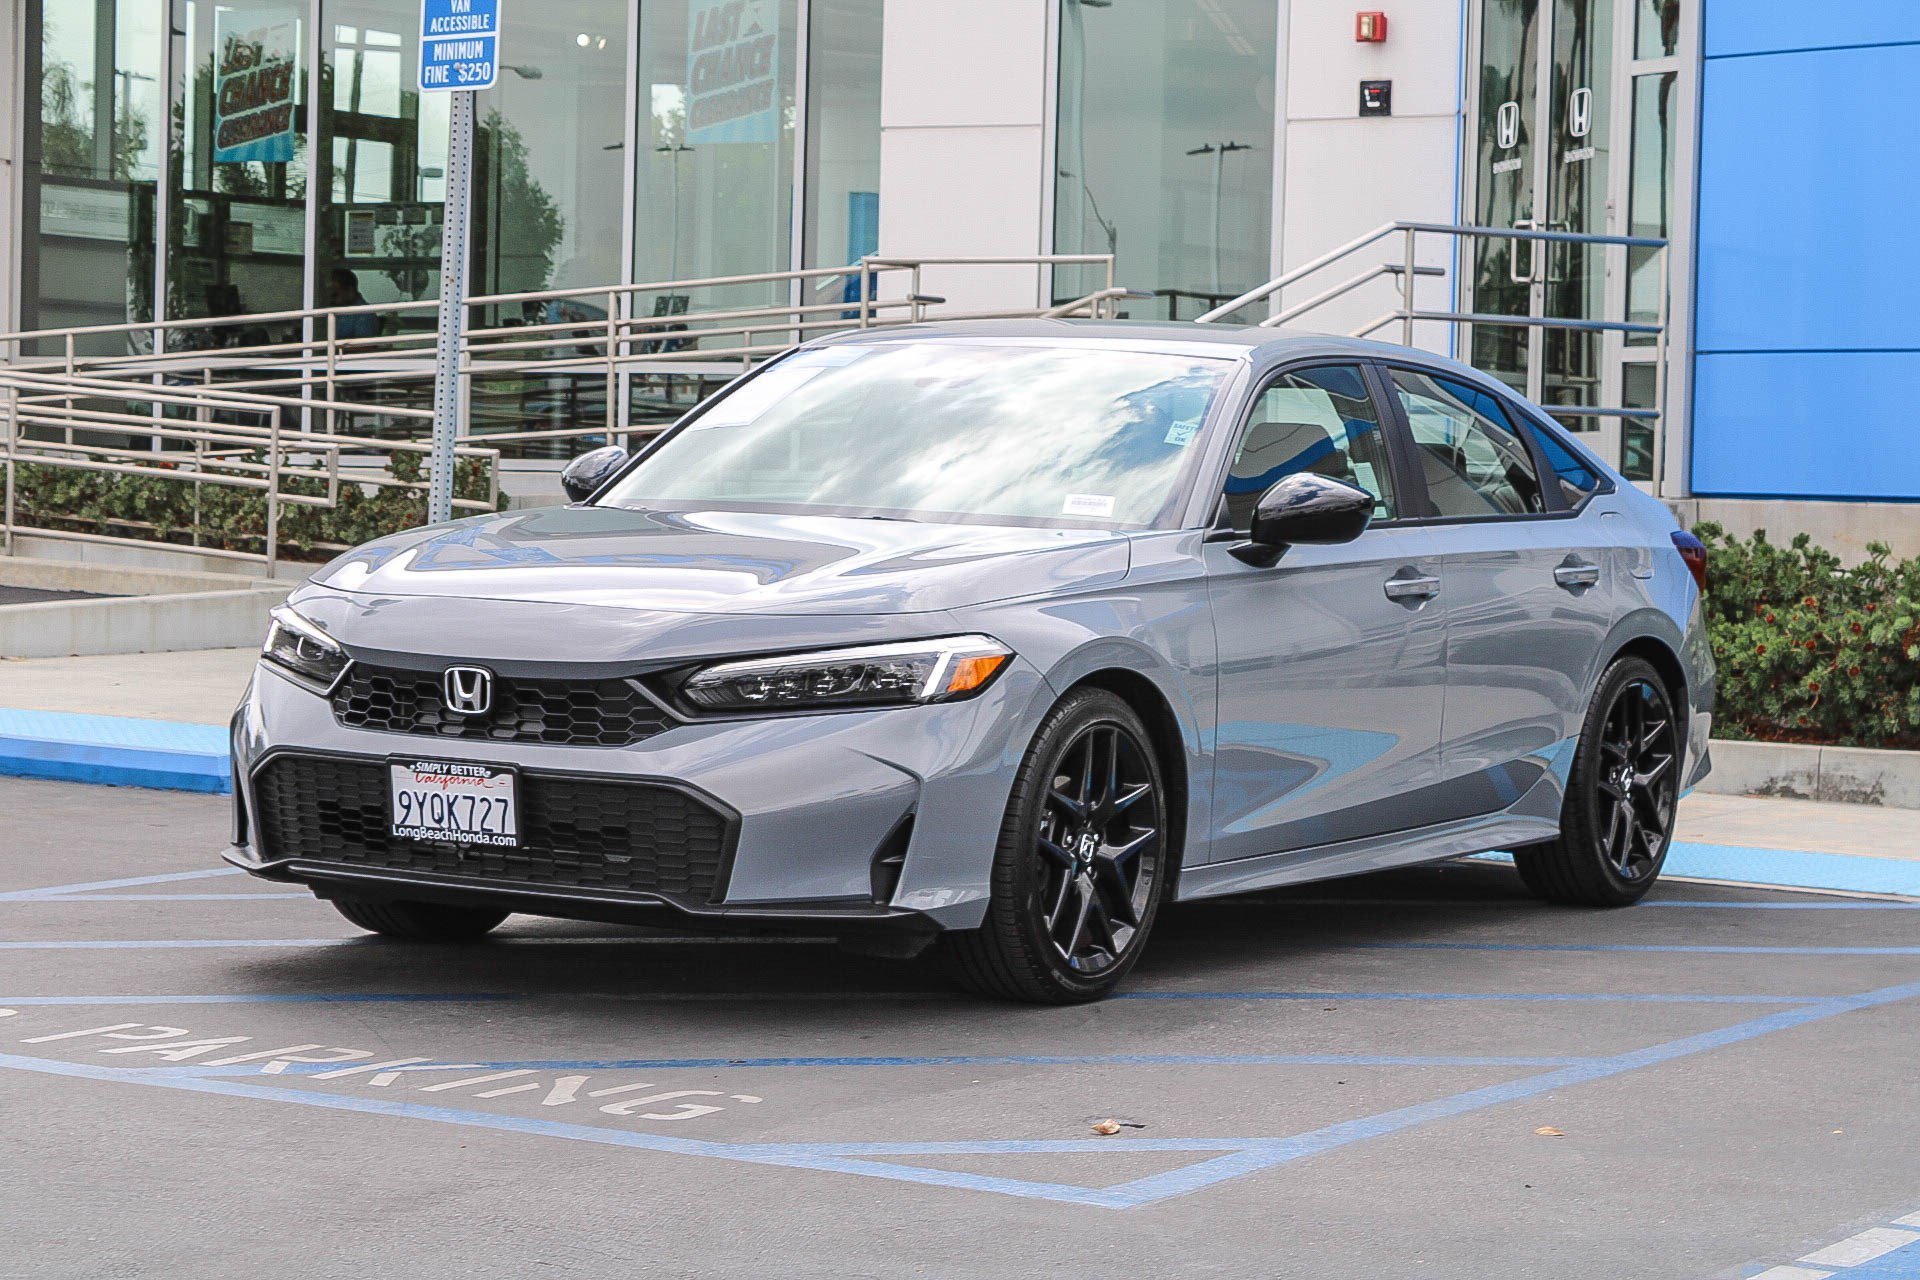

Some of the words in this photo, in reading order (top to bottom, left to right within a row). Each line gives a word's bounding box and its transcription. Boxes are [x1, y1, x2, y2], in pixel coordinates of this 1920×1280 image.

[451, 0, 471, 13] VAN
[430, 13, 490, 33] ACCESSIBLE
[433, 40, 484, 61] MINIMUM
[424, 64, 450, 84] FINE
[457, 62, 491, 83] $250
[415, 762, 449, 774] SIMPLY
[450, 765, 485, 777] BETTER
[415, 773, 492, 790] California
[398, 790, 509, 834] 9YQK727
[392, 824, 517, 846] LongBeachHonda.com
[20, 1022, 763, 1121] PARKING
